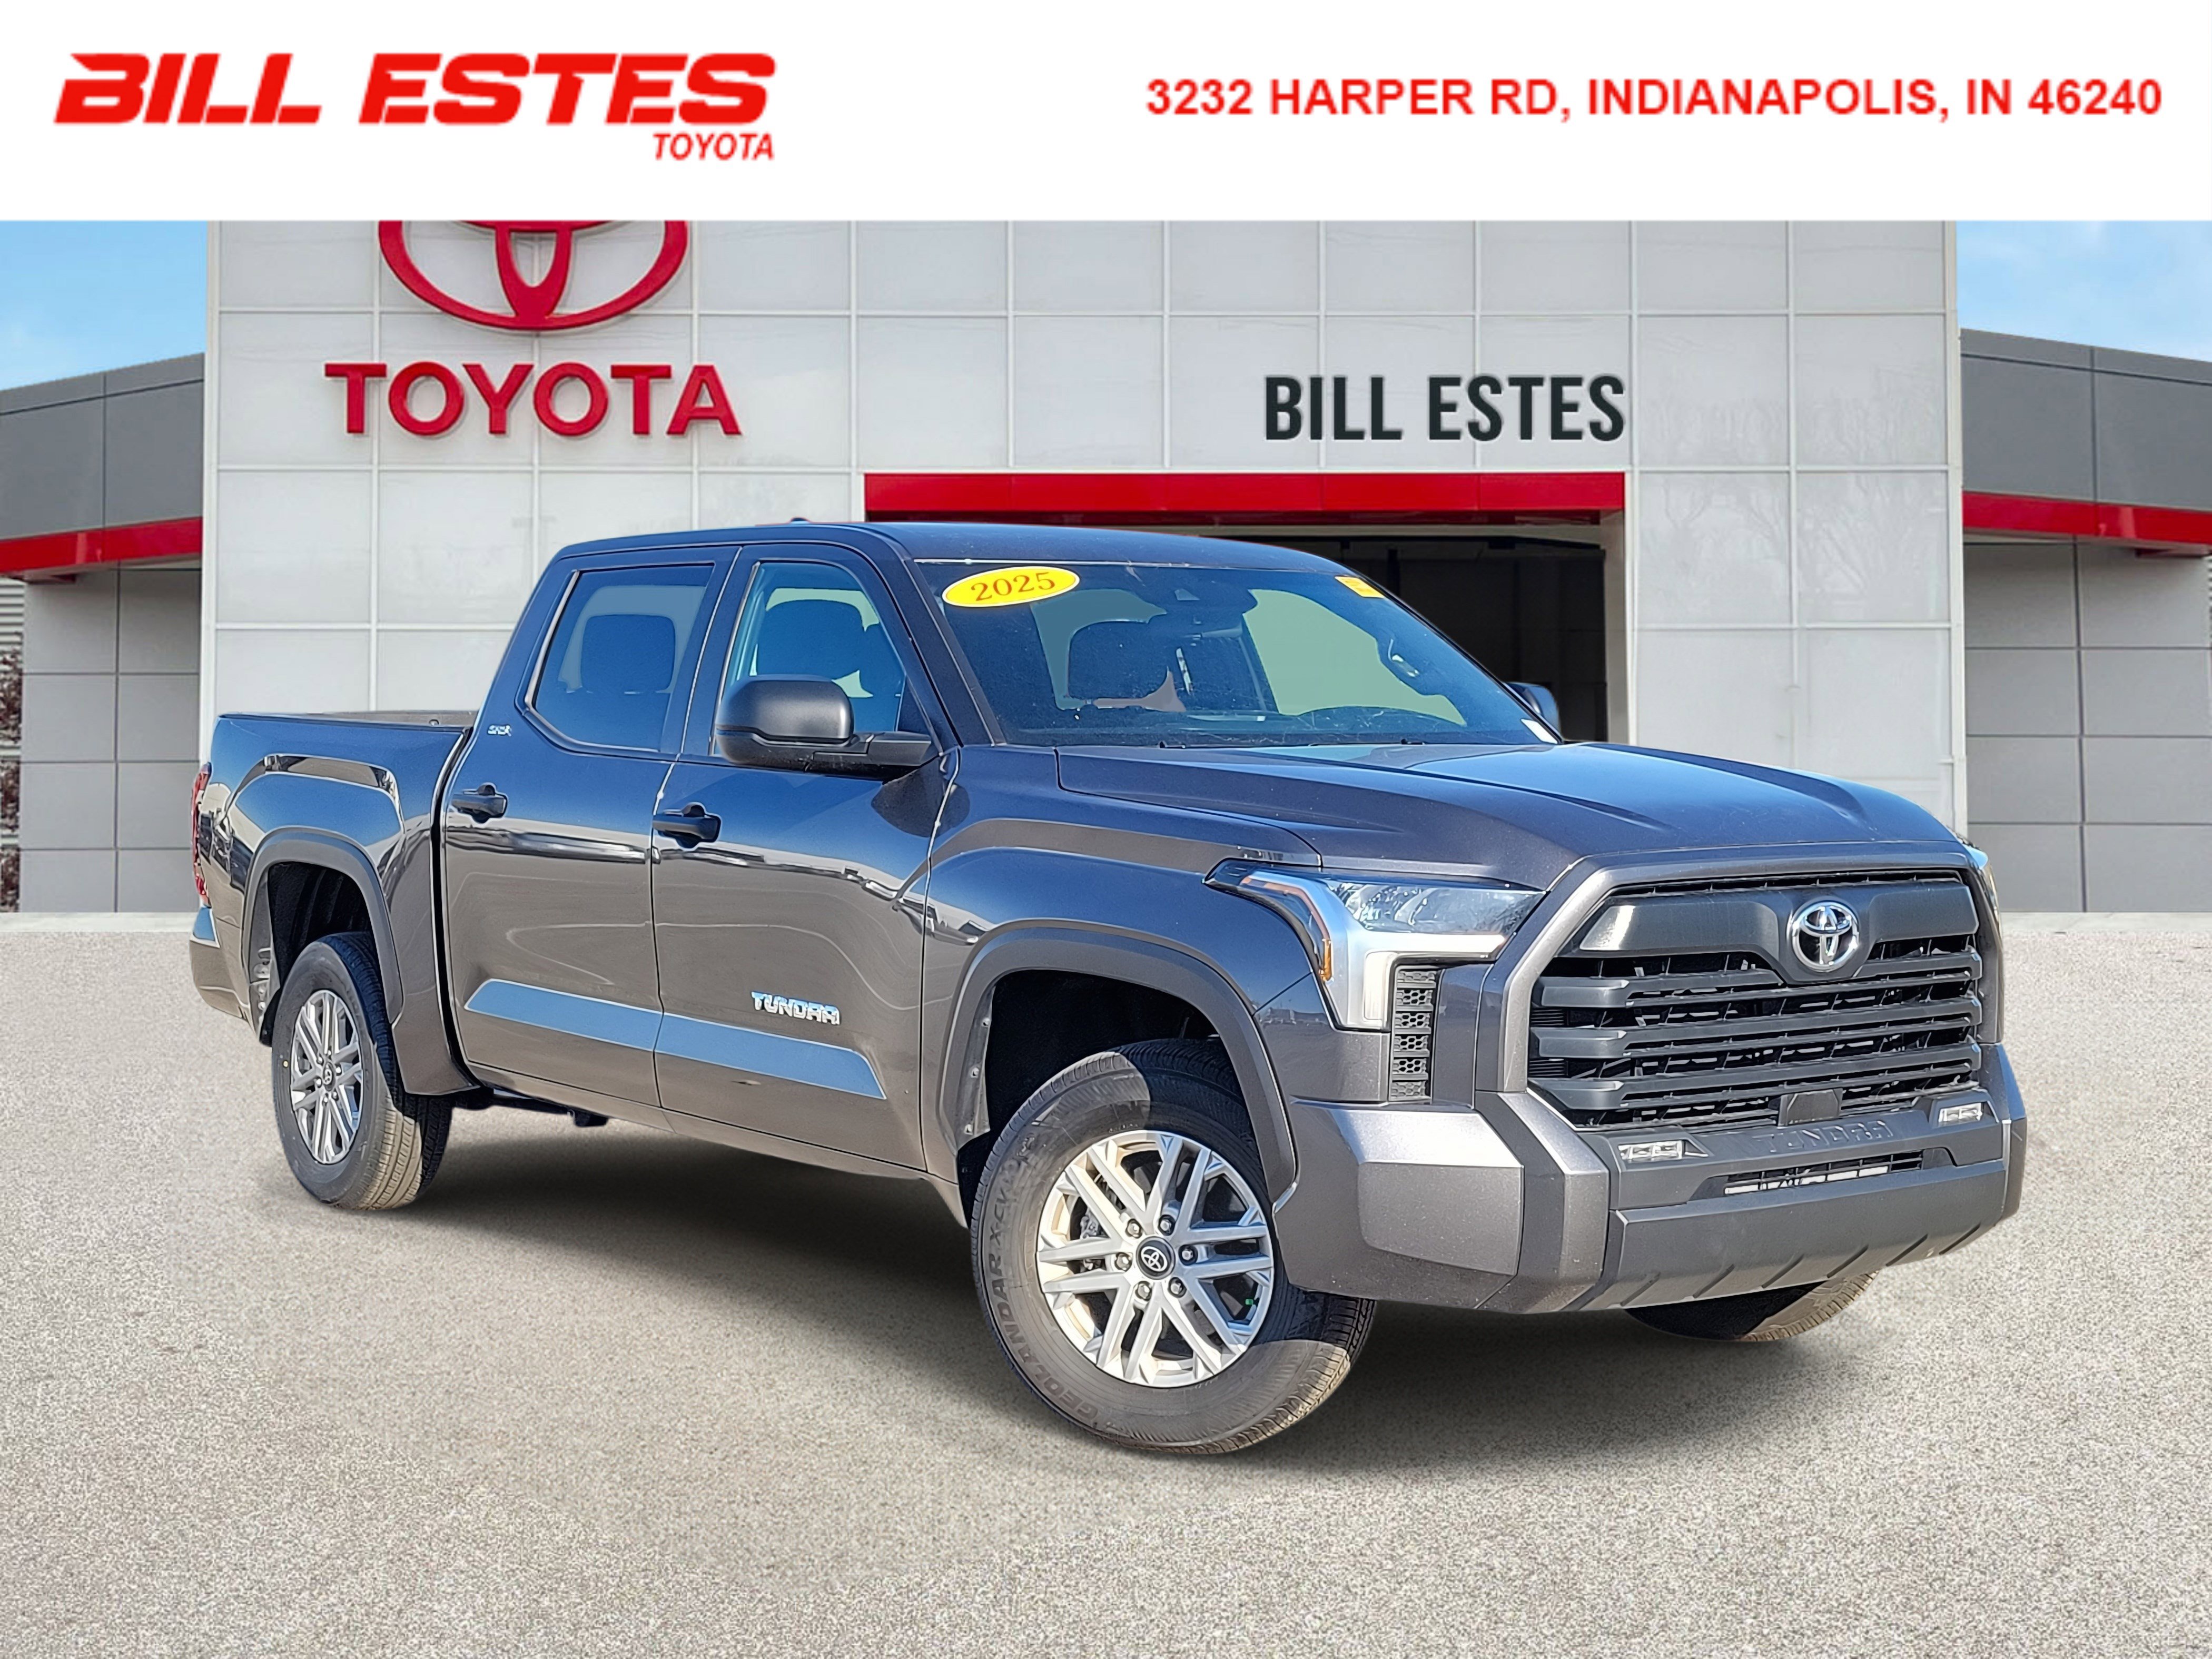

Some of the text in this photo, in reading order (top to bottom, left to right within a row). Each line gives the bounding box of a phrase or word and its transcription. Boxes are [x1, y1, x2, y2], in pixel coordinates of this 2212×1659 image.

[325, 361, 740, 436] TOYOTA
[1266, 376, 1624, 441] BILL ESTES
[971, 572, 1055, 601] 2025
[751, 991, 841, 1025] TUNDRA
[1752, 1120, 1893, 1153] TUNDRA
[989, 1253, 1099, 1419] GEOLANDAR
